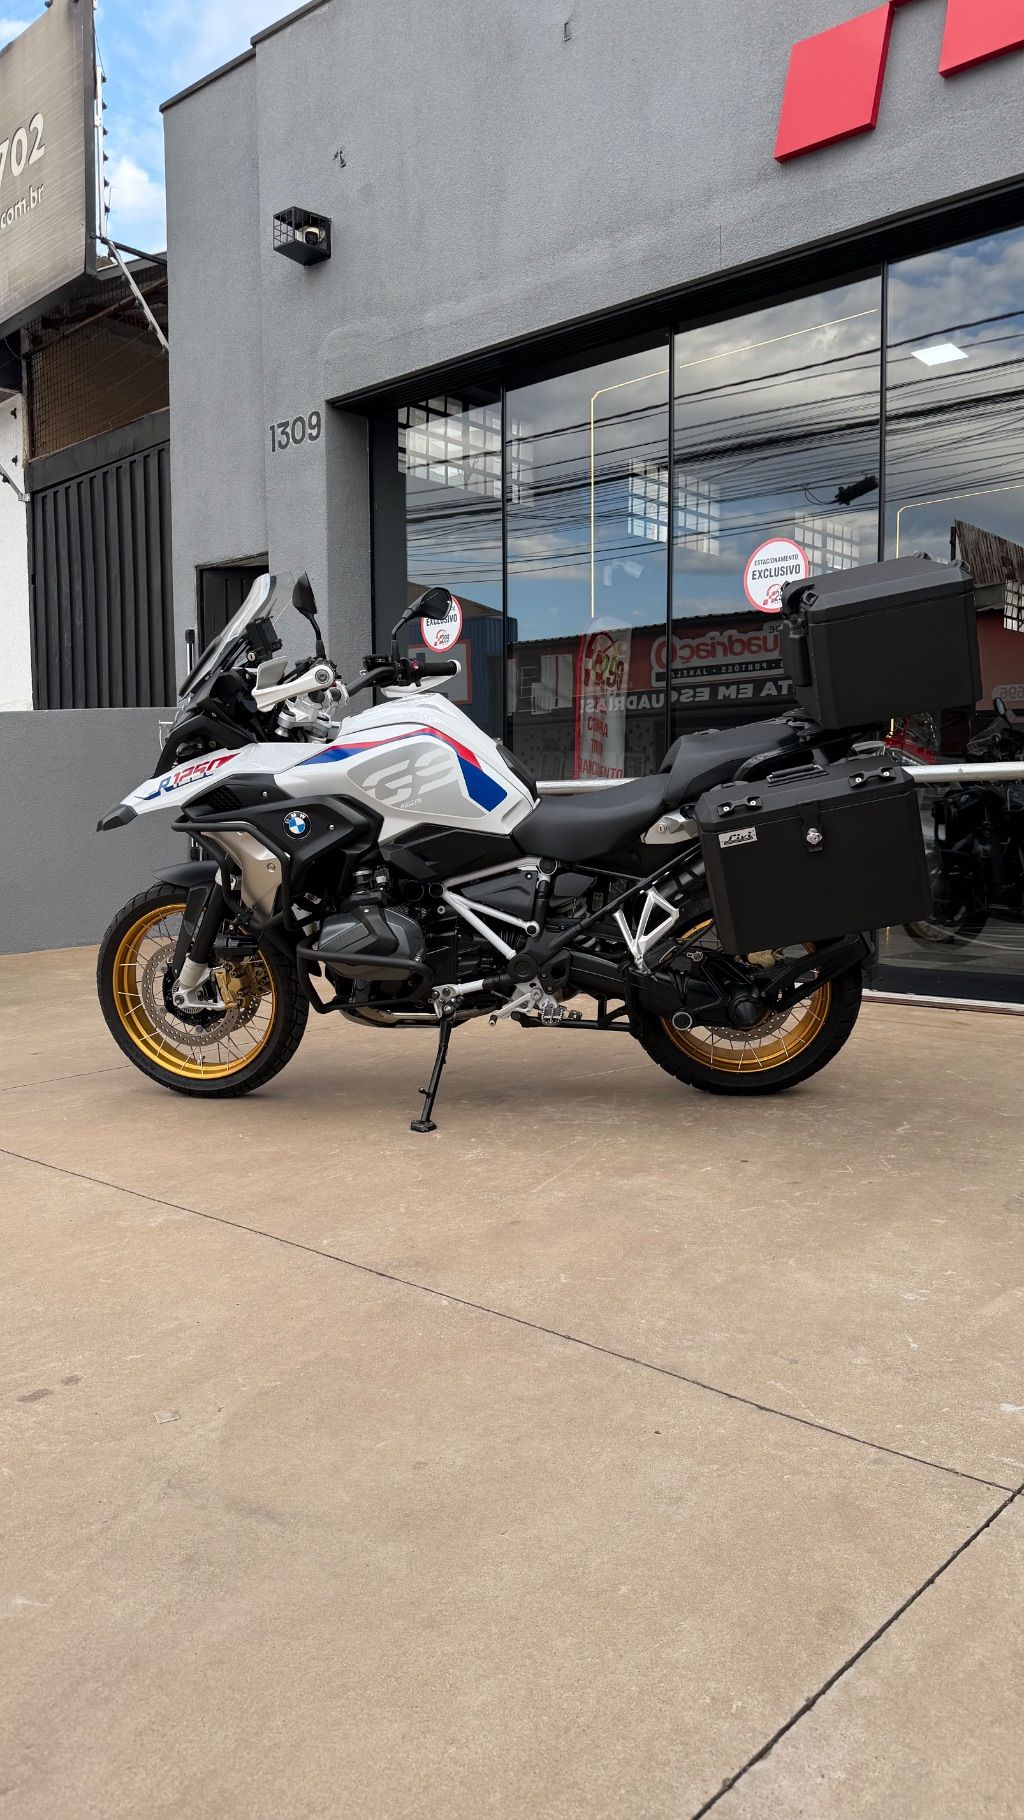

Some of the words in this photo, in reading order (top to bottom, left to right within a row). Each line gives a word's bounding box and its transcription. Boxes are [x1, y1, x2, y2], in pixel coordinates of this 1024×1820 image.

[269, 410, 322, 453] 1309
[752, 563, 801, 581] EXCLUSIVO
[754, 553, 799, 566] ESTACIONAMENTO
[361, 748, 459, 806] GS
